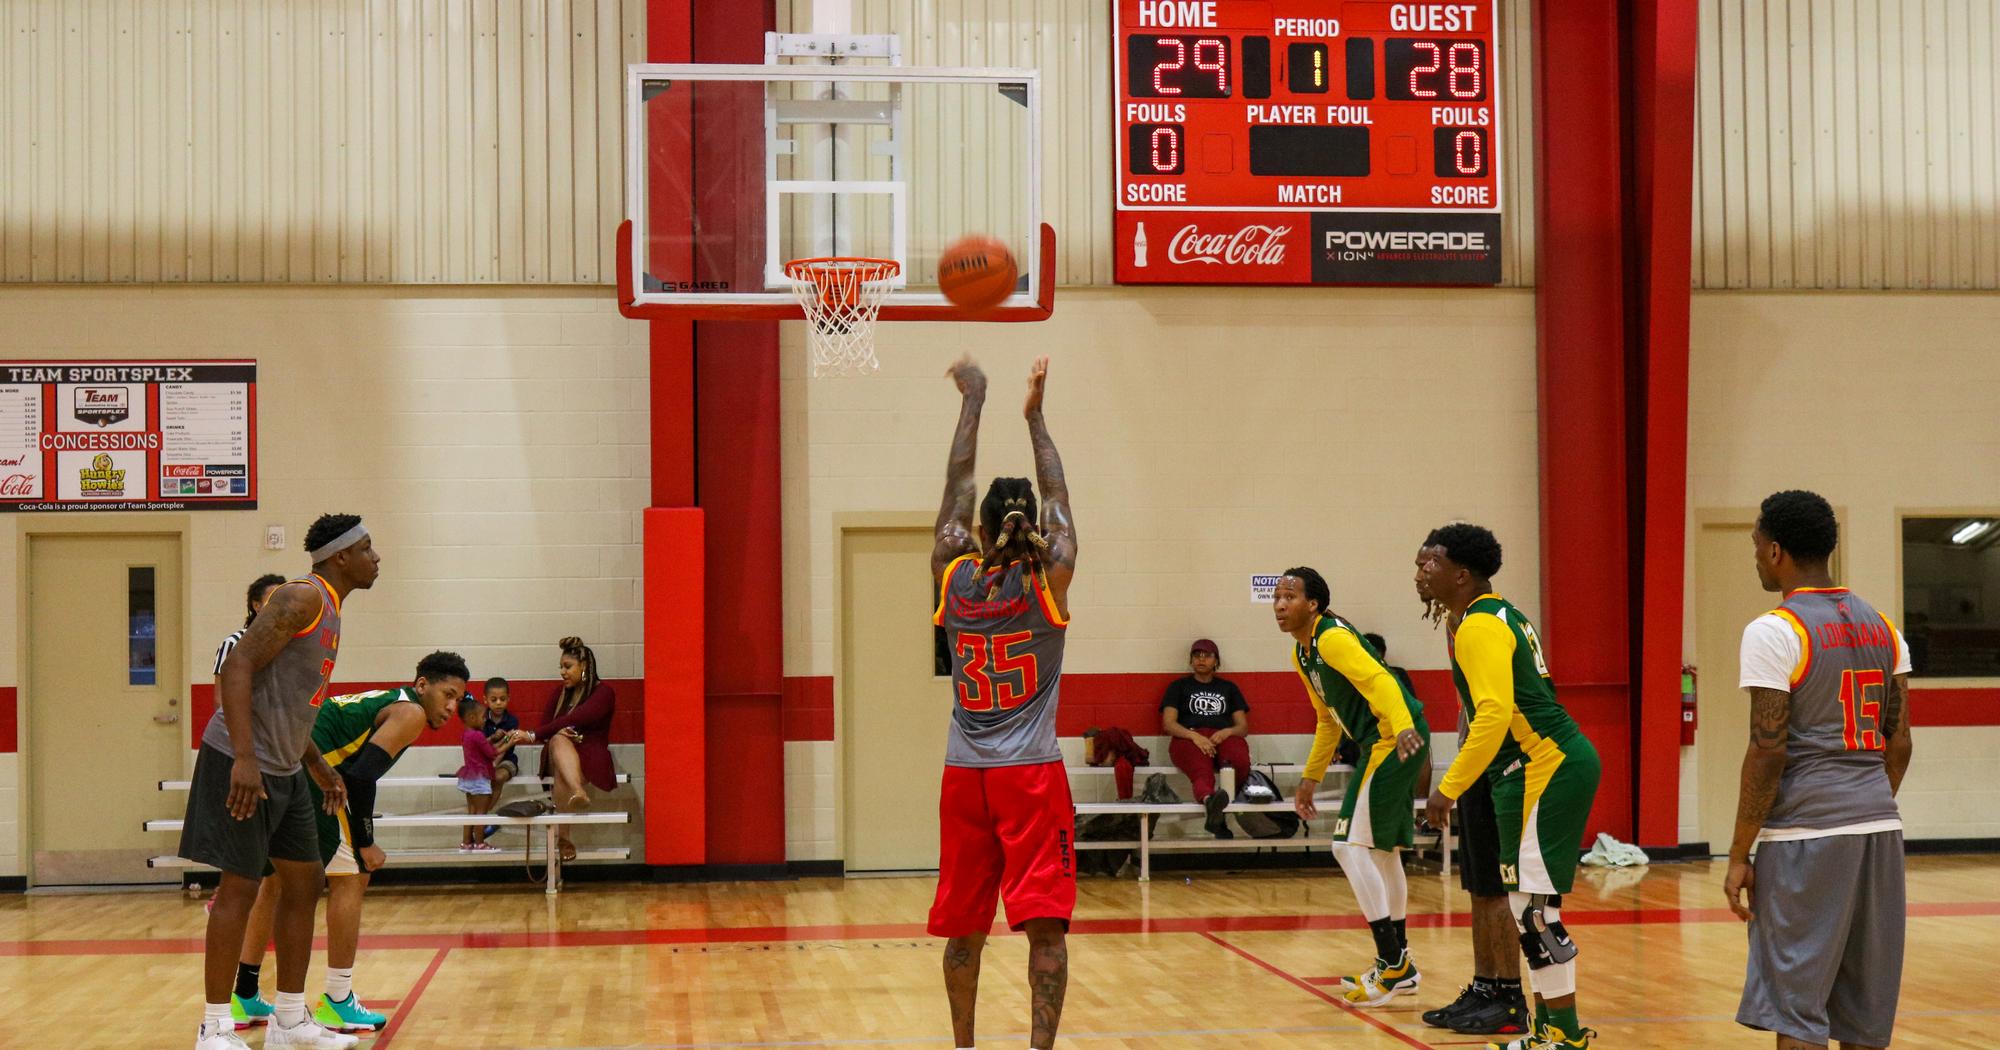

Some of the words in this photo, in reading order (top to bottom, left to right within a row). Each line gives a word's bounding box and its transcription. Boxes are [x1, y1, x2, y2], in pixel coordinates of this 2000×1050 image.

[1139, 0, 1217, 28] HOME
[1390, 4, 1478, 32] GUEST
[1275, 18, 1340, 37] PERIOD
[1153, 38, 1226, 93] 29
[1313, 49, 1322, 87] 1
[1410, 42, 1480, 98] 28
[1127, 104, 1186, 122] FOULS
[1247, 105, 1316, 124] PLAYER
[1327, 106, 1373, 125] FOUL
[1431, 107, 1489, 126] FOULS
[1152, 127, 1177, 171] 0
[1456, 131, 1481, 174] 0
[1127, 184, 1187, 202] SCORE
[1278, 185, 1342, 204] MATCH
[1431, 186, 1490, 205] SCORE
[1168, 224, 1292, 265] Coca-Cola
[679, 281, 729, 290] GARED
[8, 367, 63, 382] TEAM
[69, 367, 193, 382] SPORTSPLEX
[85, 390, 119, 403] TEAM
[42, 434, 159, 450] CONCESSIONS
[80, 468, 127, 481] Hungry
[18, 502, 53, 510] Coca-Cola
[54, 502, 59, 510] is
[66, 502, 88, 512] proud
[88, 503, 117, 512] sponsor
[146, 502, 184, 511] Sportsplex
[1253, 577, 1281, 586] NOTIC
[1815, 622, 1890, 651] LOUISIANA
[956, 630, 1039, 712] 35
[1838, 668, 1887, 752] 15
